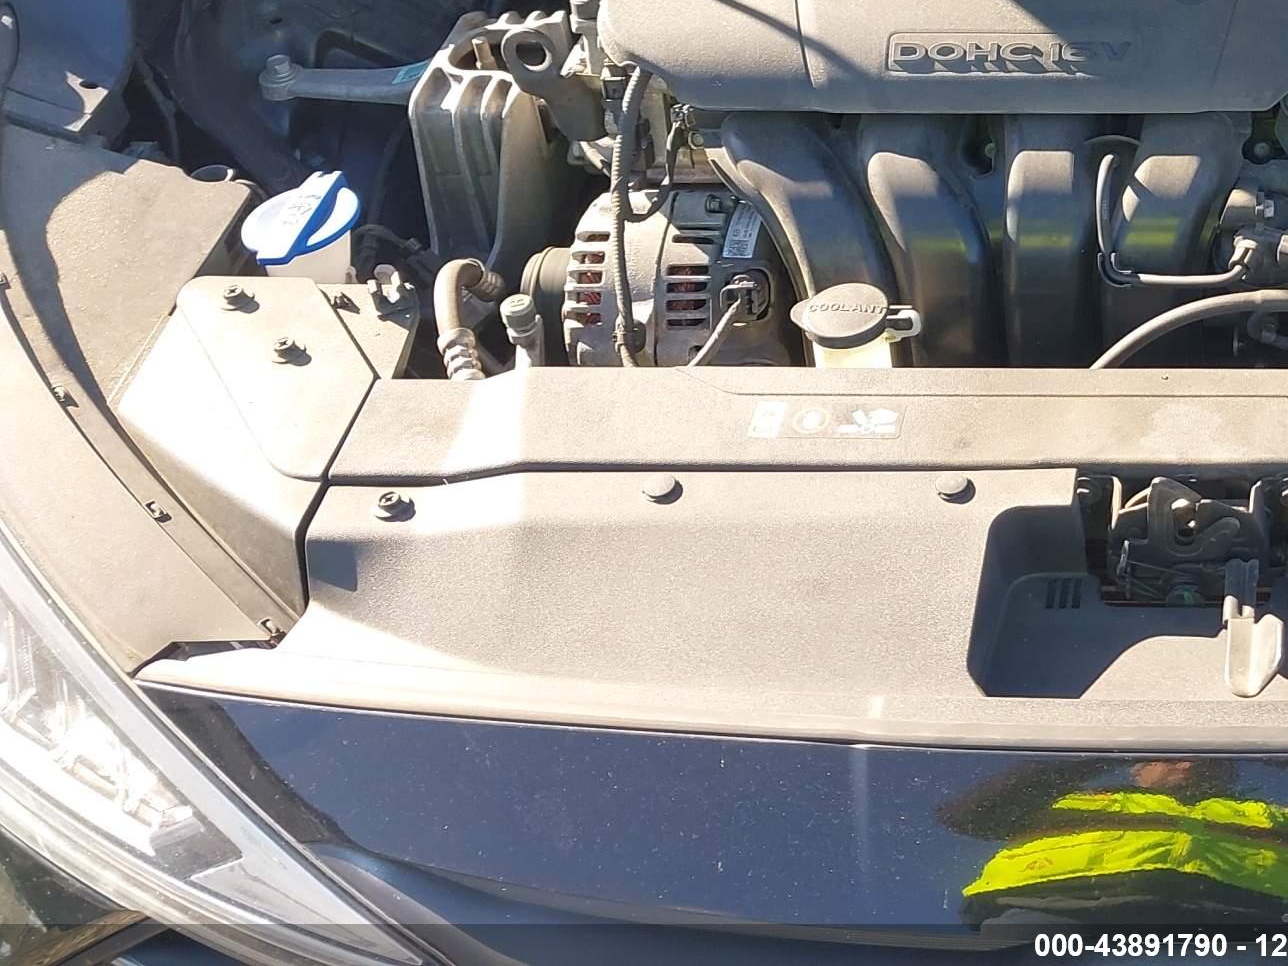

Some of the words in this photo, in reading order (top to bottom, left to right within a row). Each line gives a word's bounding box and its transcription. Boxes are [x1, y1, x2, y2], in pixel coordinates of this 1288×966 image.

[892, 42, 1042, 62] DOHC
[1049, 41, 1132, 61] 16V
[809, 303, 887, 315] COOLANT
